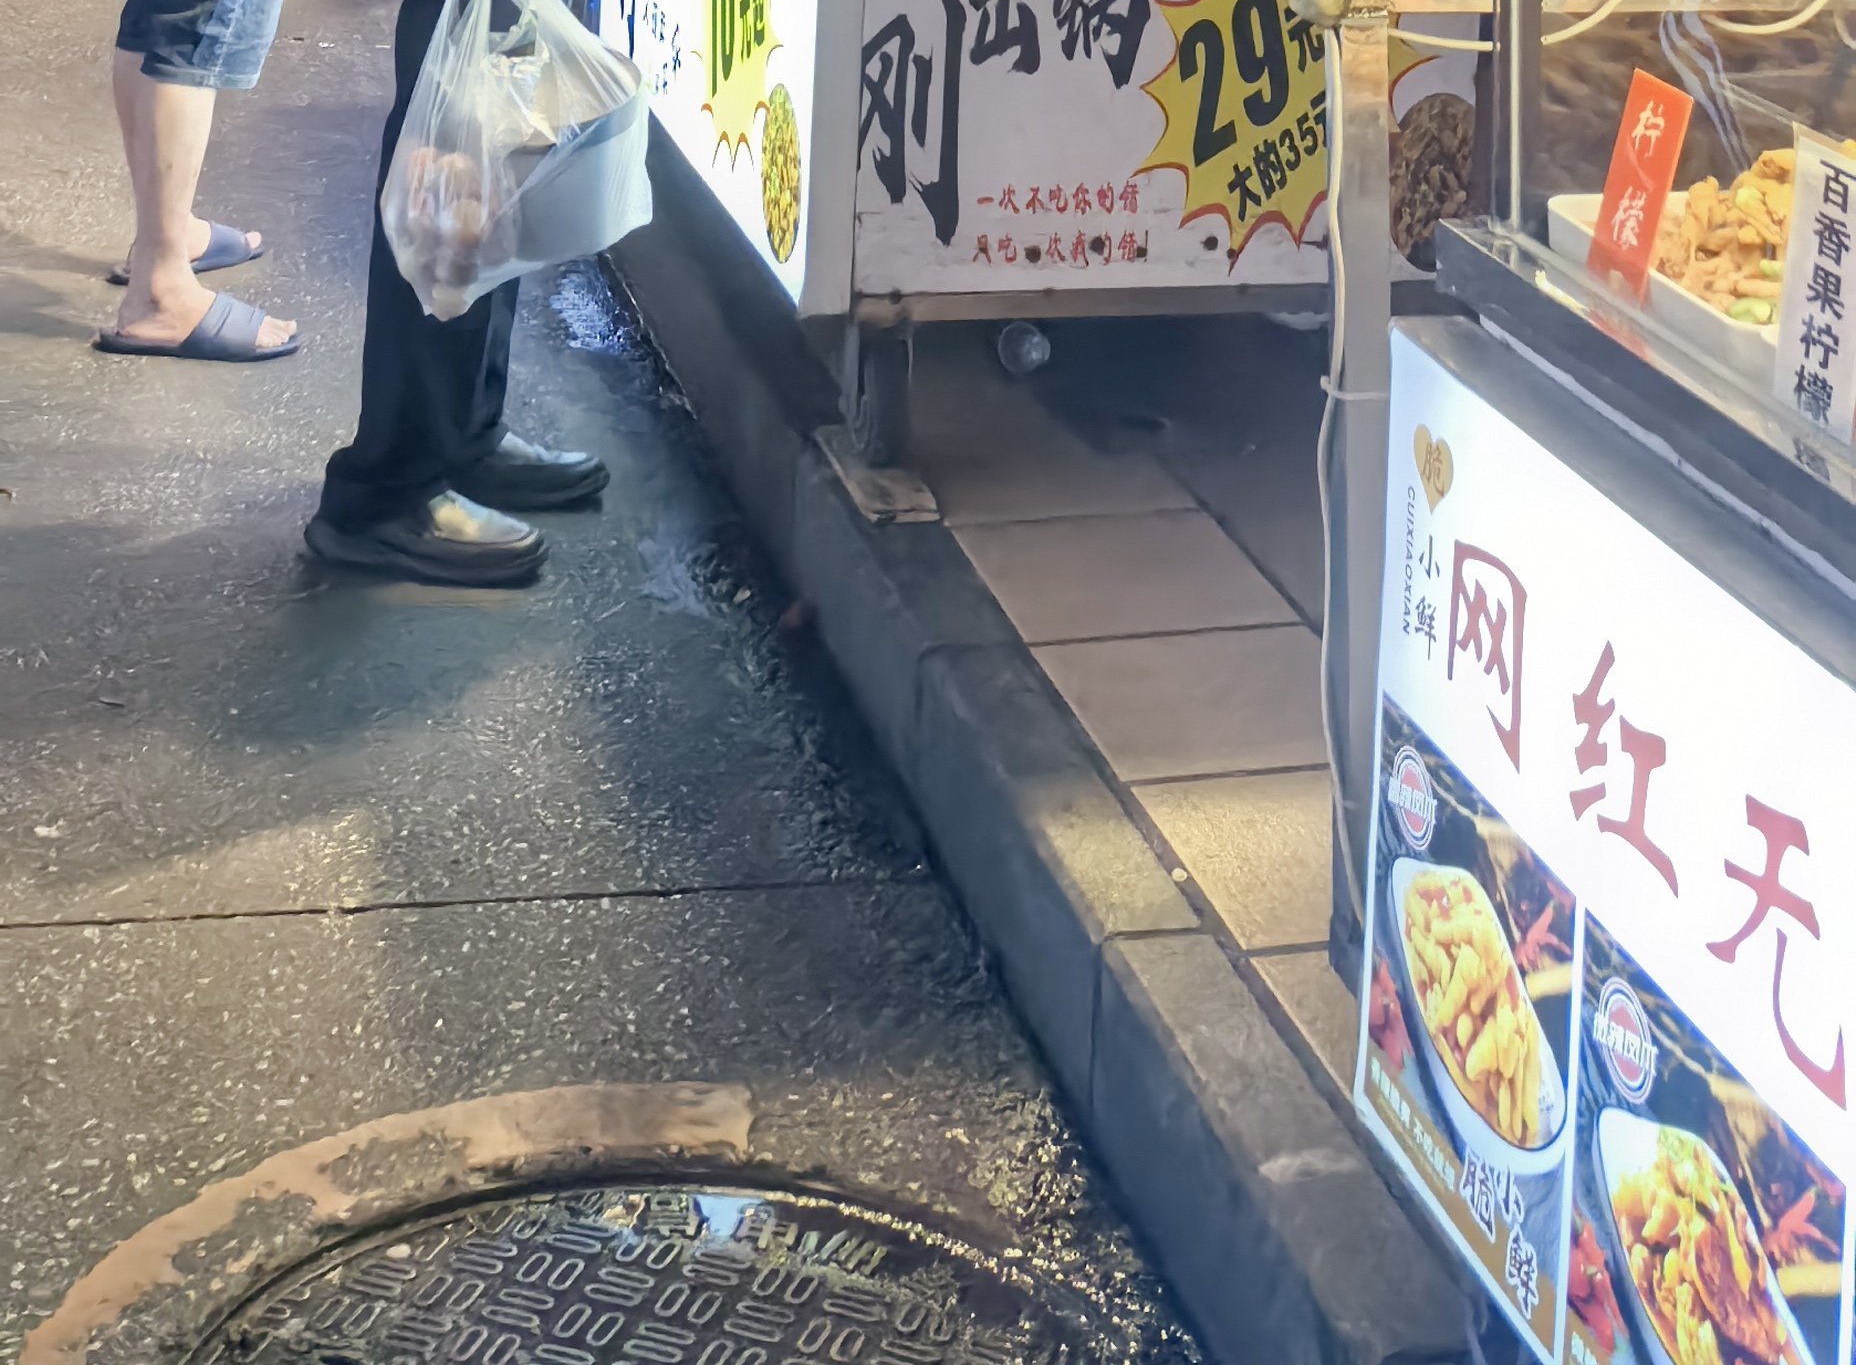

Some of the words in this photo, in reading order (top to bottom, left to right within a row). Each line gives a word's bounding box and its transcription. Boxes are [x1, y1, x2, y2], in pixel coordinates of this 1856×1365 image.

[972, 229, 1148, 268] 只吃次我错!
[976, 181, 1139, 216] 一次不吃你的错
[1612, 100, 1666, 250] 柠檬
[1794, 158, 1856, 425] 百香果柠檬
[1402, 484, 1416, 636] CUIXIAOXIAN
[1447, 539, 1847, 1112] 网红无
